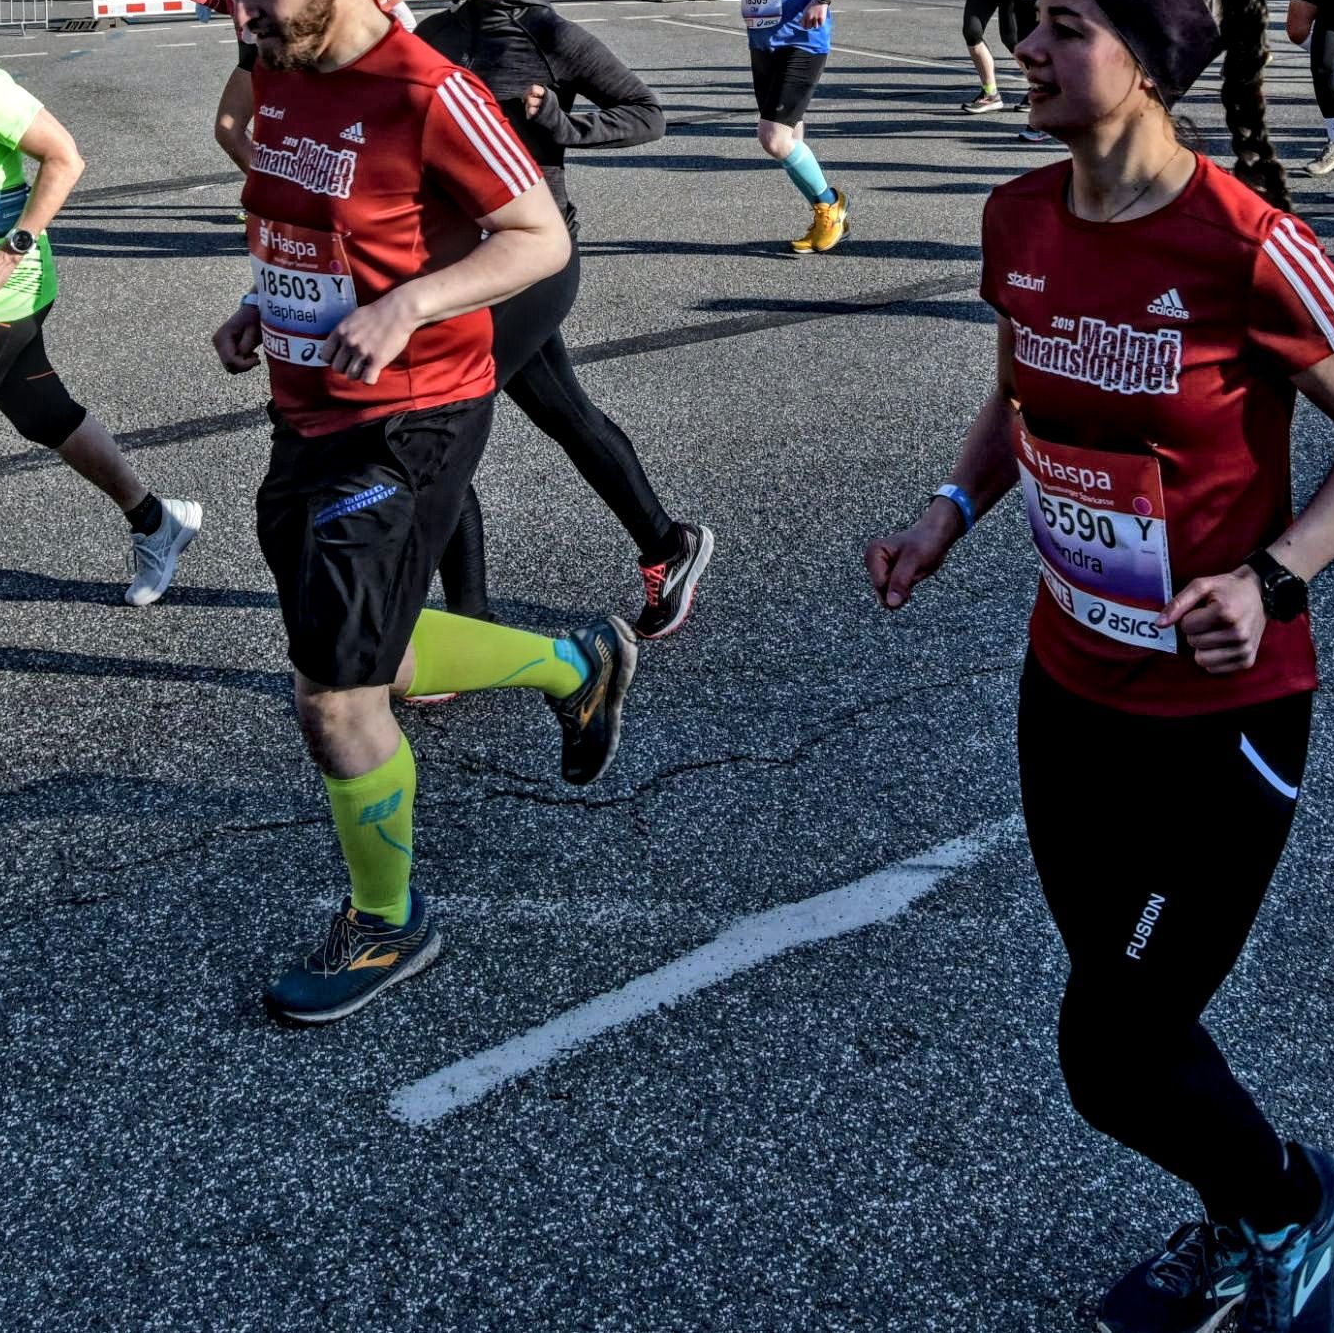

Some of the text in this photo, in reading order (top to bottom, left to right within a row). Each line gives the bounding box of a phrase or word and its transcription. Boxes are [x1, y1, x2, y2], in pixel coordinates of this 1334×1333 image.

[271, 232, 317, 259] Haspa
[260, 267, 344, 303] 18503 Y
[1007, 271, 1046, 293] stadium
[266, 300, 317, 324] Raphael
[1051, 316, 1075, 332] 2019
[1147, 303, 1190, 320] adidas
[1078, 317, 1183, 370] Malmö
[1012, 322, 1181, 395] idnattsloppet
[1036, 451, 1112, 492] Haspa
[1135, 517, 1153, 542] Y
[1108, 612, 1160, 640] asics
[1126, 892, 1166, 961] FUSION
